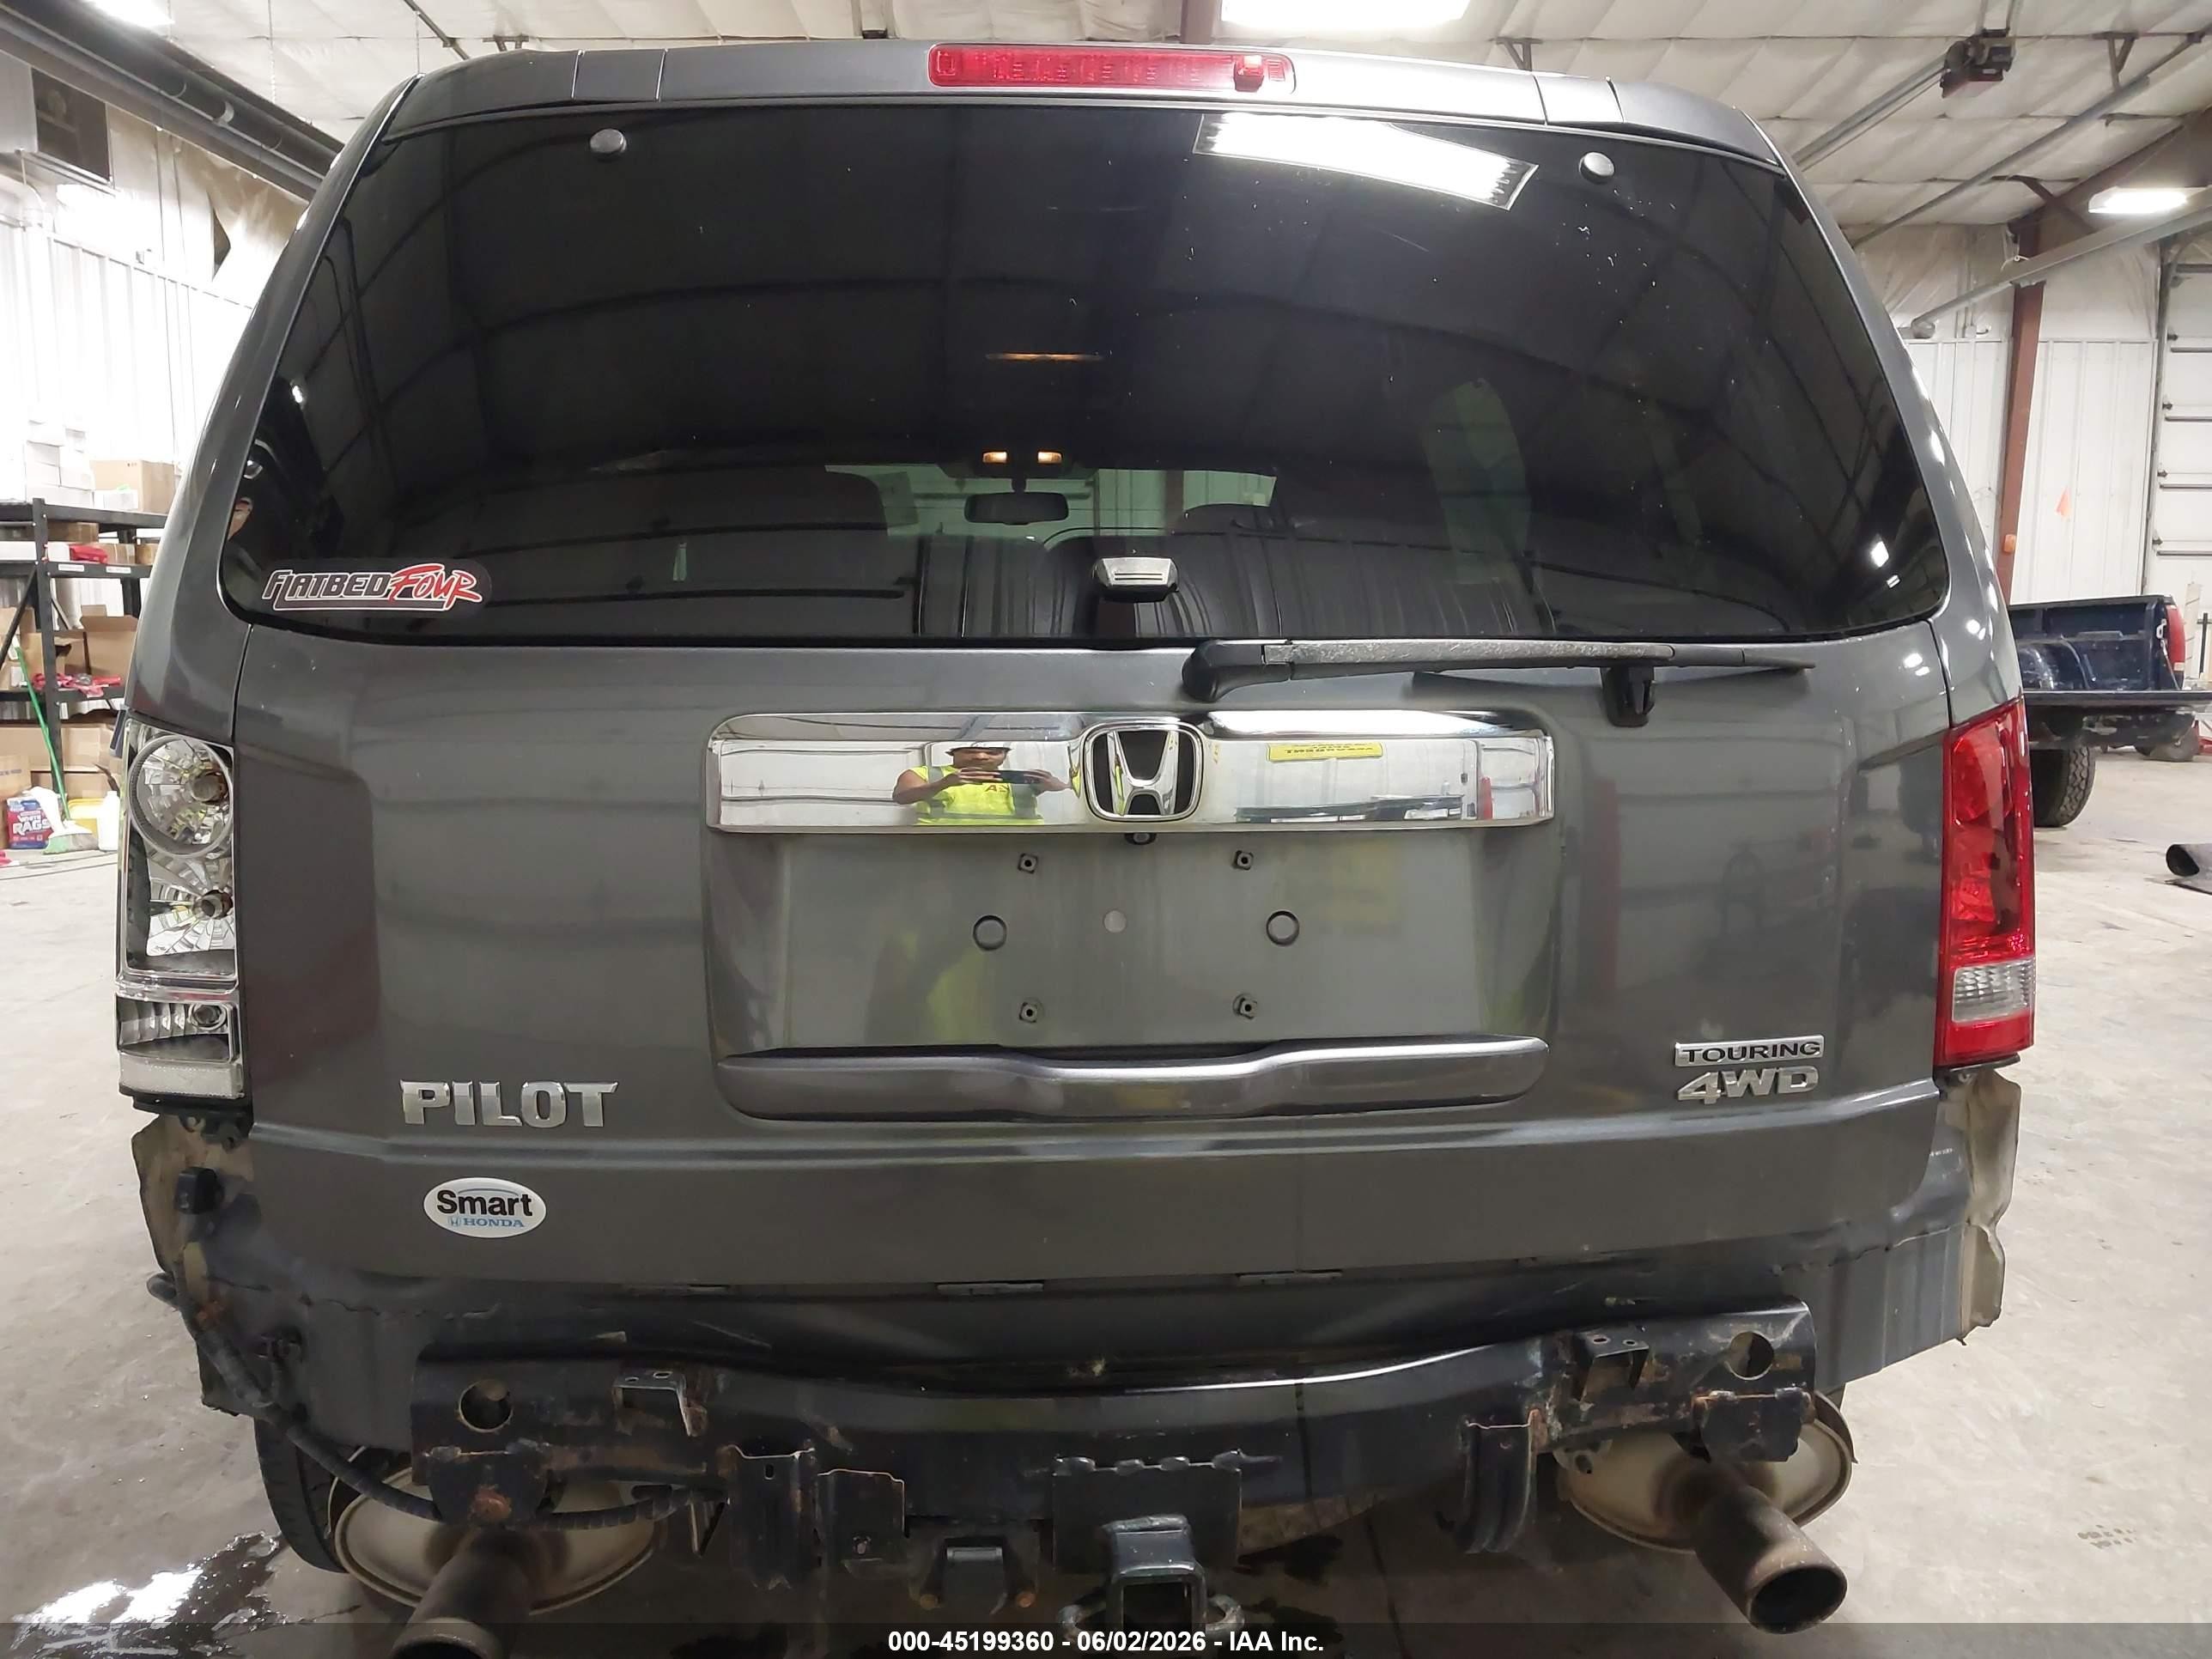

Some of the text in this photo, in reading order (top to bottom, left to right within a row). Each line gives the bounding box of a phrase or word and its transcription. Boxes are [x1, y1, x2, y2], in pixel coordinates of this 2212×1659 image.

[262, 569, 392, 606] FLATBED
[12, 818, 52, 836] RAGS
[1682, 1041, 1821, 1063] TOURING
[1677, 1066, 1819, 1104] 4WD
[399, 1079, 619, 1128] PILOT
[436, 1189, 533, 1217] Smart
[463, 1218, 525, 1228] HONDA
